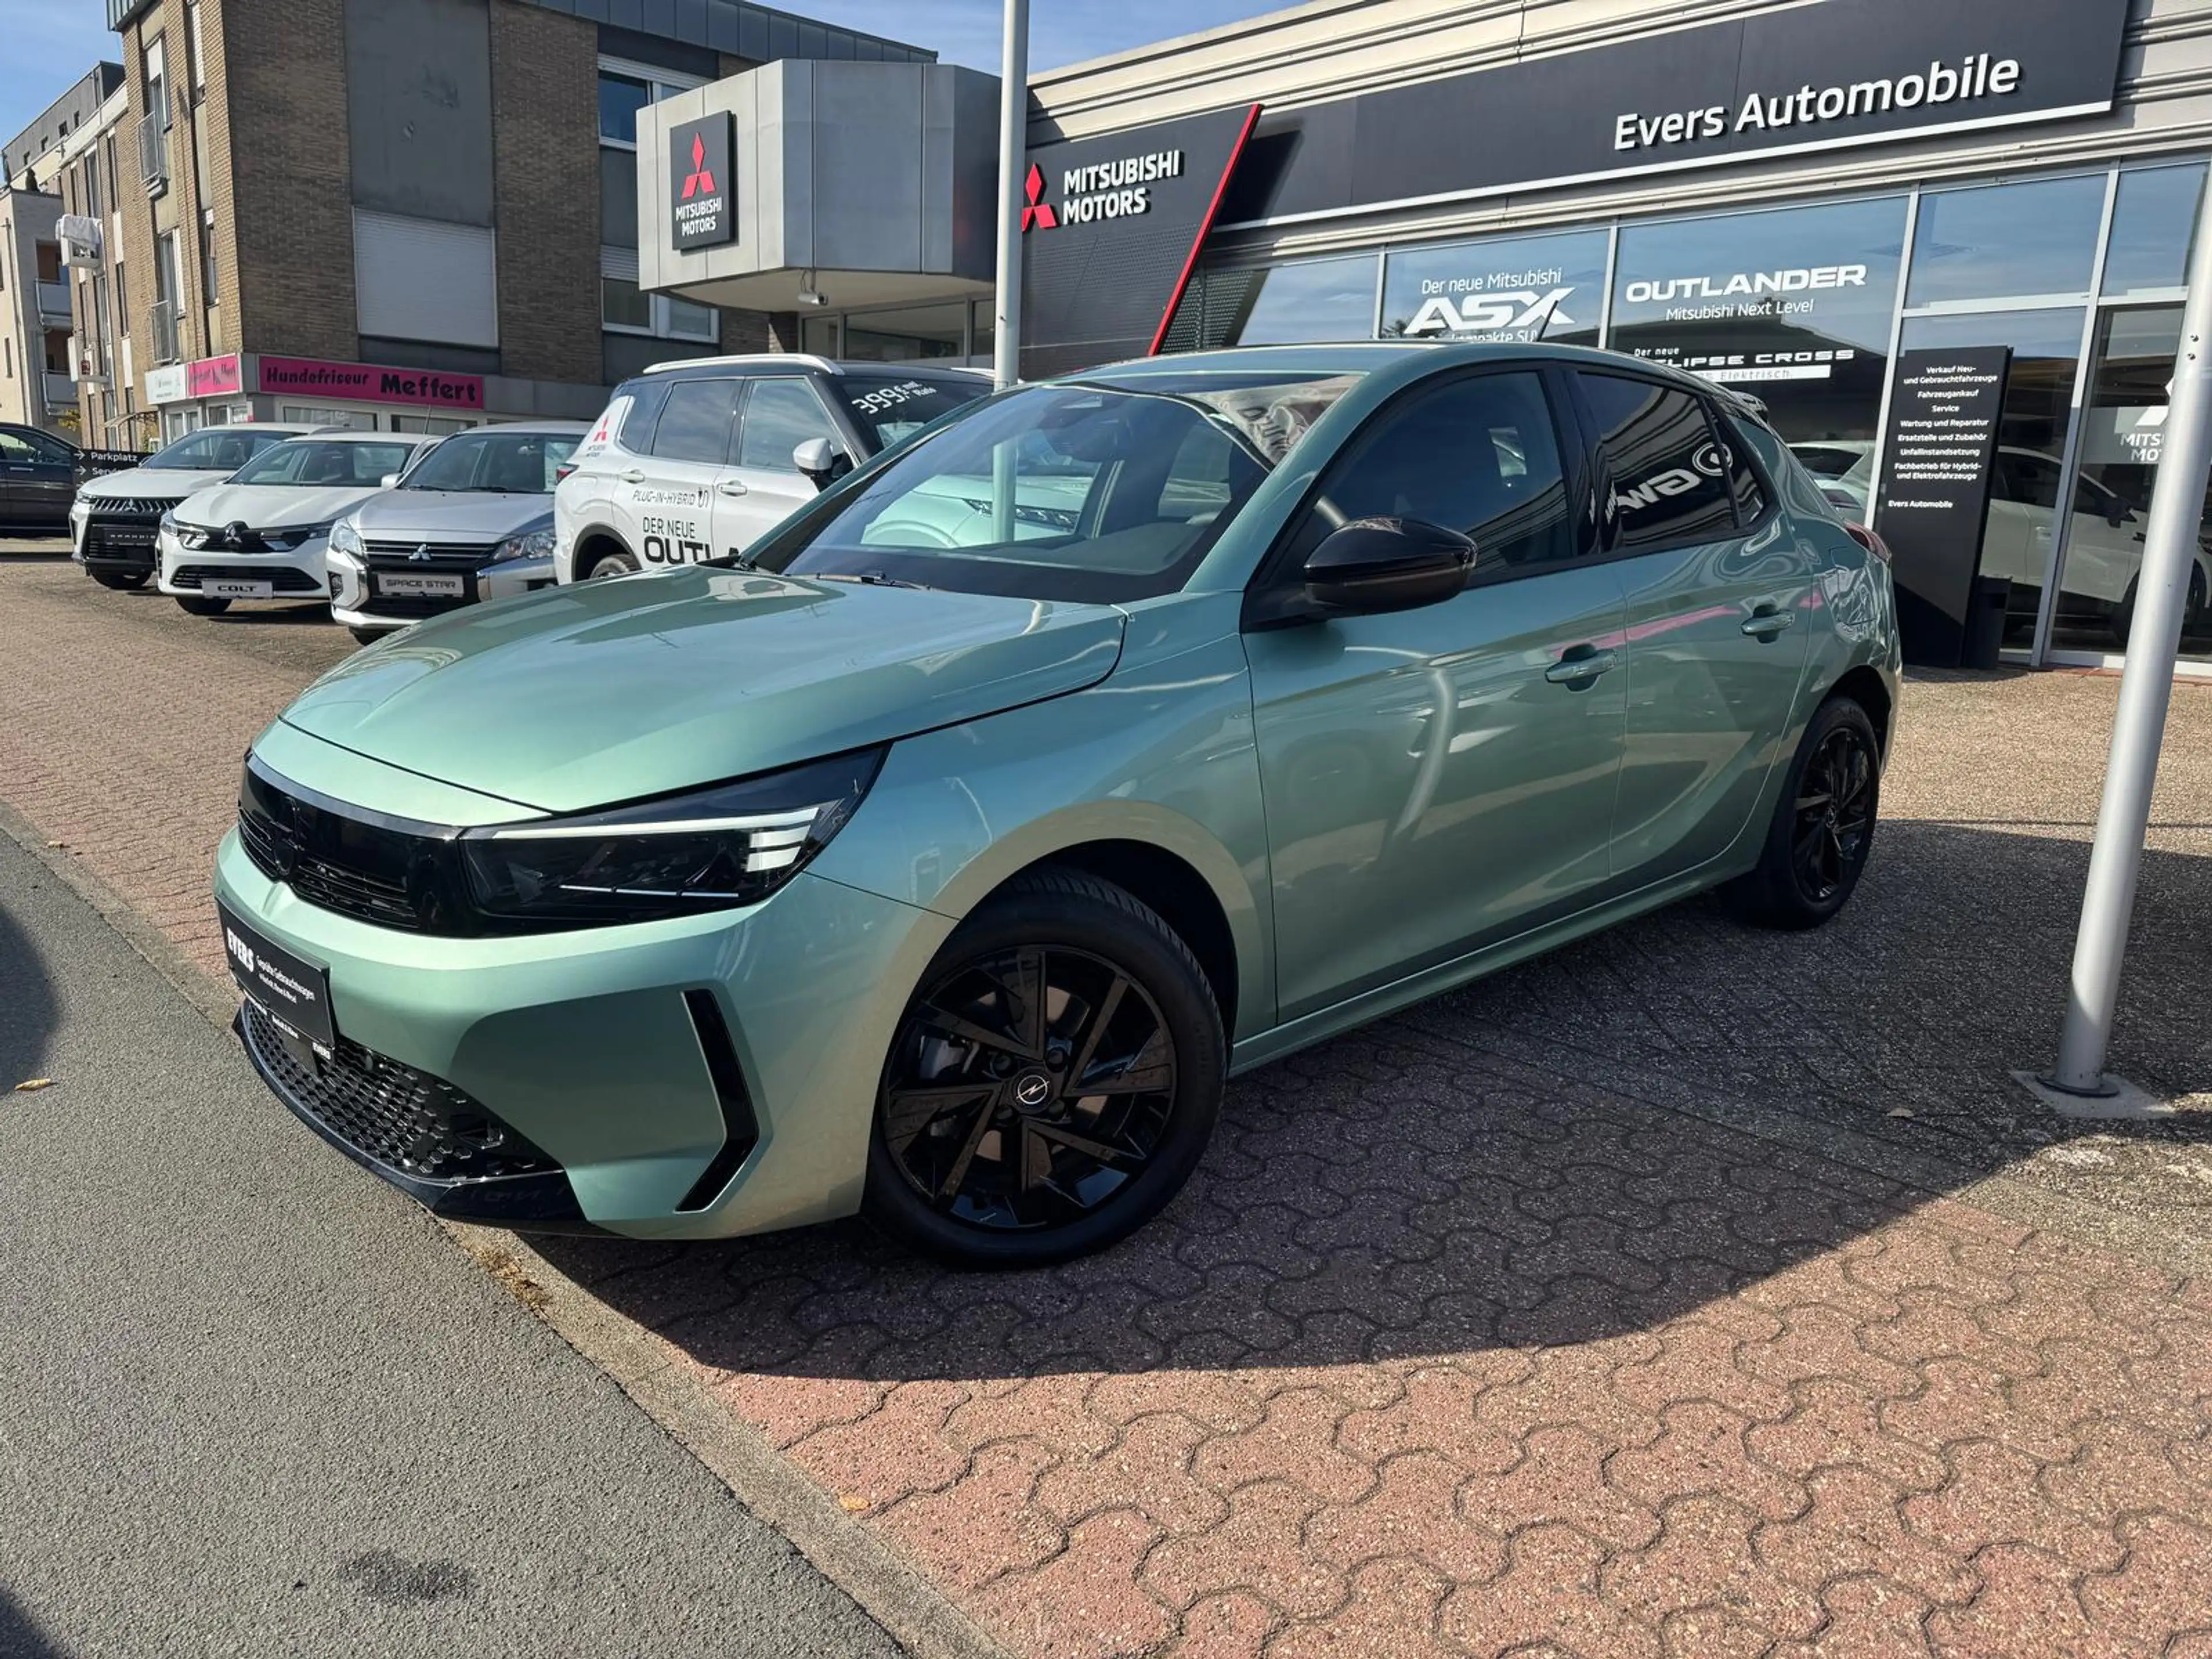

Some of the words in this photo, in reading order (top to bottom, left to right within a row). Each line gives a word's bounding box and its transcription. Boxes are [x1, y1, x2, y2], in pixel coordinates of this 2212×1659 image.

[1614, 106, 1725, 151] Evers
[1734, 53, 2020, 132] Automobile
[1063, 149, 1180, 195] MITSUBISHI
[676, 196, 722, 221] MITSUBISHI
[1063, 187, 1146, 225] MOTORS
[681, 215, 717, 237] MOTORS
[1421, 279, 1445, 294] Der
[1448, 278, 1483, 292] neue
[1487, 267, 1563, 289] Mitsubishi
[1625, 264, 1867, 302] OUTLANDER
[1403, 287, 1576, 334] ASX
[1666, 303, 1734, 321] Mitsubishi
[1737, 301, 1772, 316] Next
[1775, 298, 1814, 314] Level
[1634, 348, 1652, 357] Der
[1654, 347, 1680, 355] neue
[1755, 350, 1855, 364] CROSS
[1926, 365, 1956, 374] Verkauf
[266, 367, 369, 386] Hundefriseur
[380, 373, 476, 402] Meffert
[1919, 375, 1998, 384] Gebrauchtfahrzeuge
[1917, 389, 1979, 399] Fahrzeugankauf
[1950, 419, 1989, 427] Reparatur
[1897, 434, 1937, 442] Ersatzteile
[1955, 433, 1987, 441] Zubehör
[2119, 433, 2165, 446] MITS
[90, 452, 138, 462] Parkplatz
[1900, 448, 1980, 457] Unfallinstandsetzung
[2131, 448, 2162, 461] MO
[1952, 463, 1982, 471] Hybrid-
[1912, 472, 1978, 481] Elektrofahrzeuge
[632, 488, 696, 506] PLUG-IN-HYBRID
[1909, 499, 1953, 508] Automobile
[643, 516, 664, 535] DER
[667, 520, 696, 539] NEUE
[218, 585, 257, 593] COLT
[385, 578, 423, 587] SPACE
[425, 580, 456, 588] STAR
[226, 926, 254, 973] EVERS
